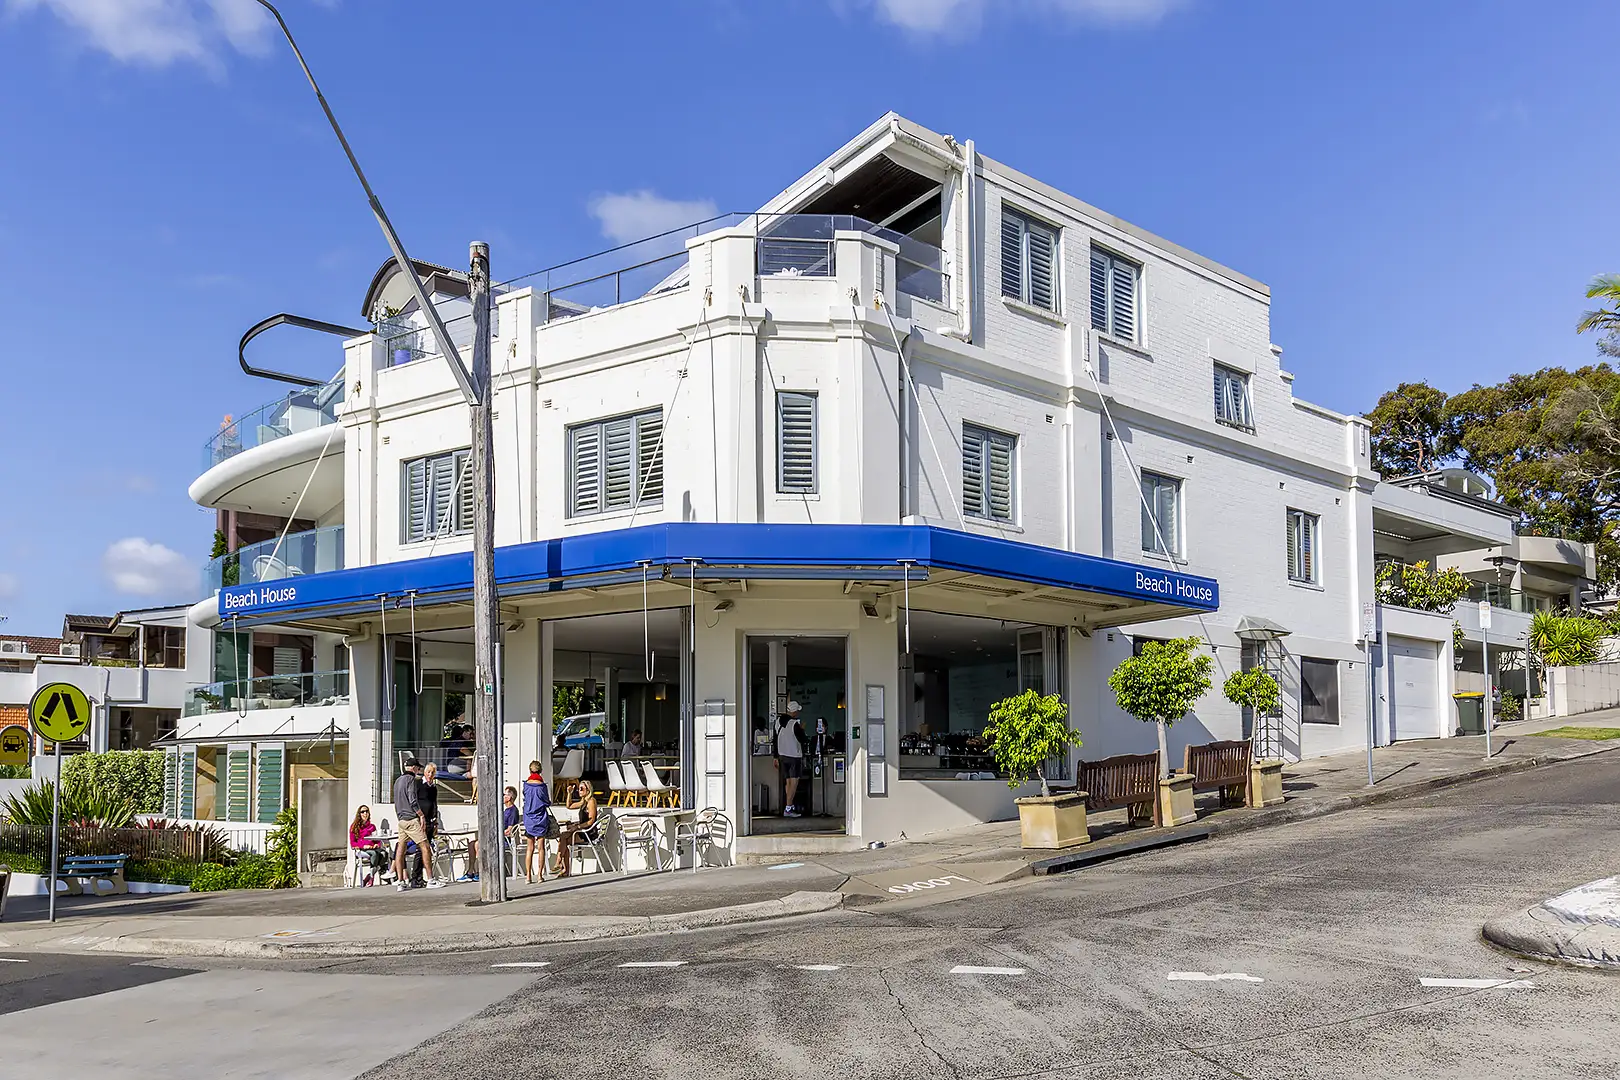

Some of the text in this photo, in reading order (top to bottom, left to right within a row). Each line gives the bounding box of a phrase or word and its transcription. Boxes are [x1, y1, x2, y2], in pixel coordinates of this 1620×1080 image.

[1136, 572, 1212, 600] Beach House
[225, 587, 296, 608] Beach House
[891, 876, 969, 893] LOOK
